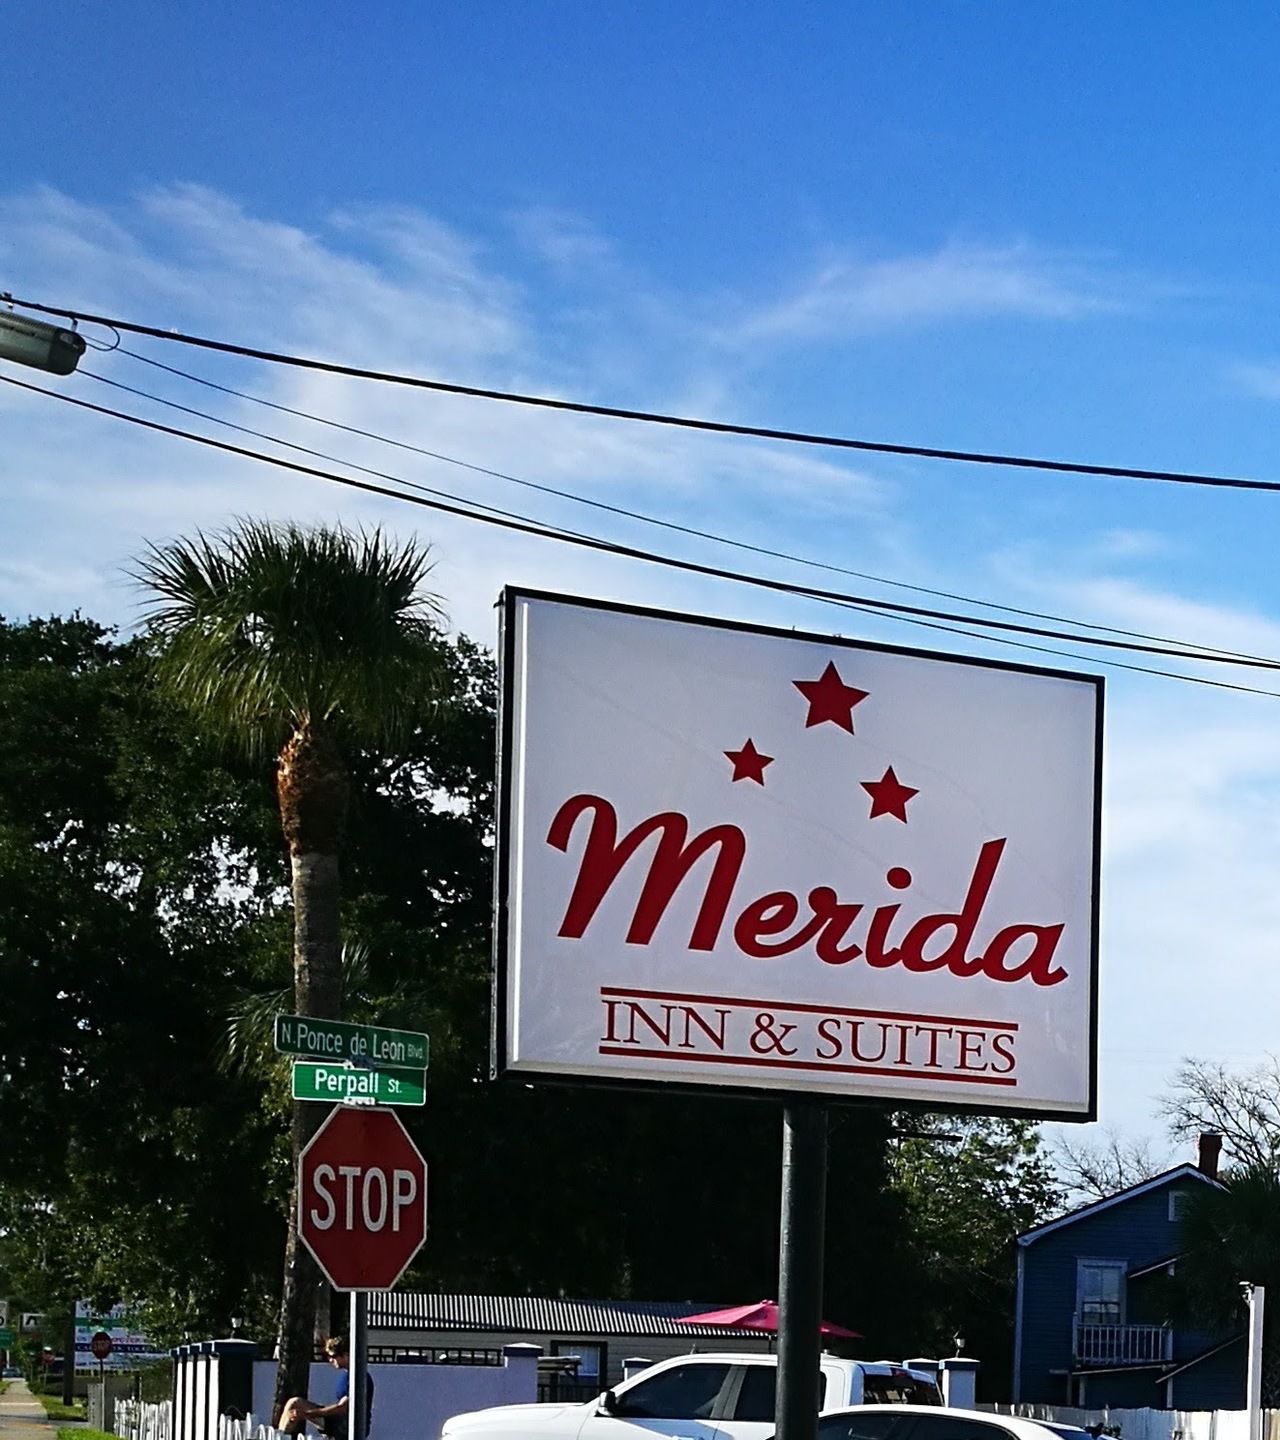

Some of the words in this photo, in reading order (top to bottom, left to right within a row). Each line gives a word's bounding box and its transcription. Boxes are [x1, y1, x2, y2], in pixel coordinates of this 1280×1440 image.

[546, 793, 1067, 987] Merida
[350, 1032, 367, 1056] de
[373, 1033, 405, 1062] Leon
[600, 999, 731, 1049] INN
[749, 1012, 798, 1057] &
[816, 1018, 1016, 1074] SUITES
[315, 1068, 379, 1096] Perpall
[311, 1163, 417, 1233] STOP
